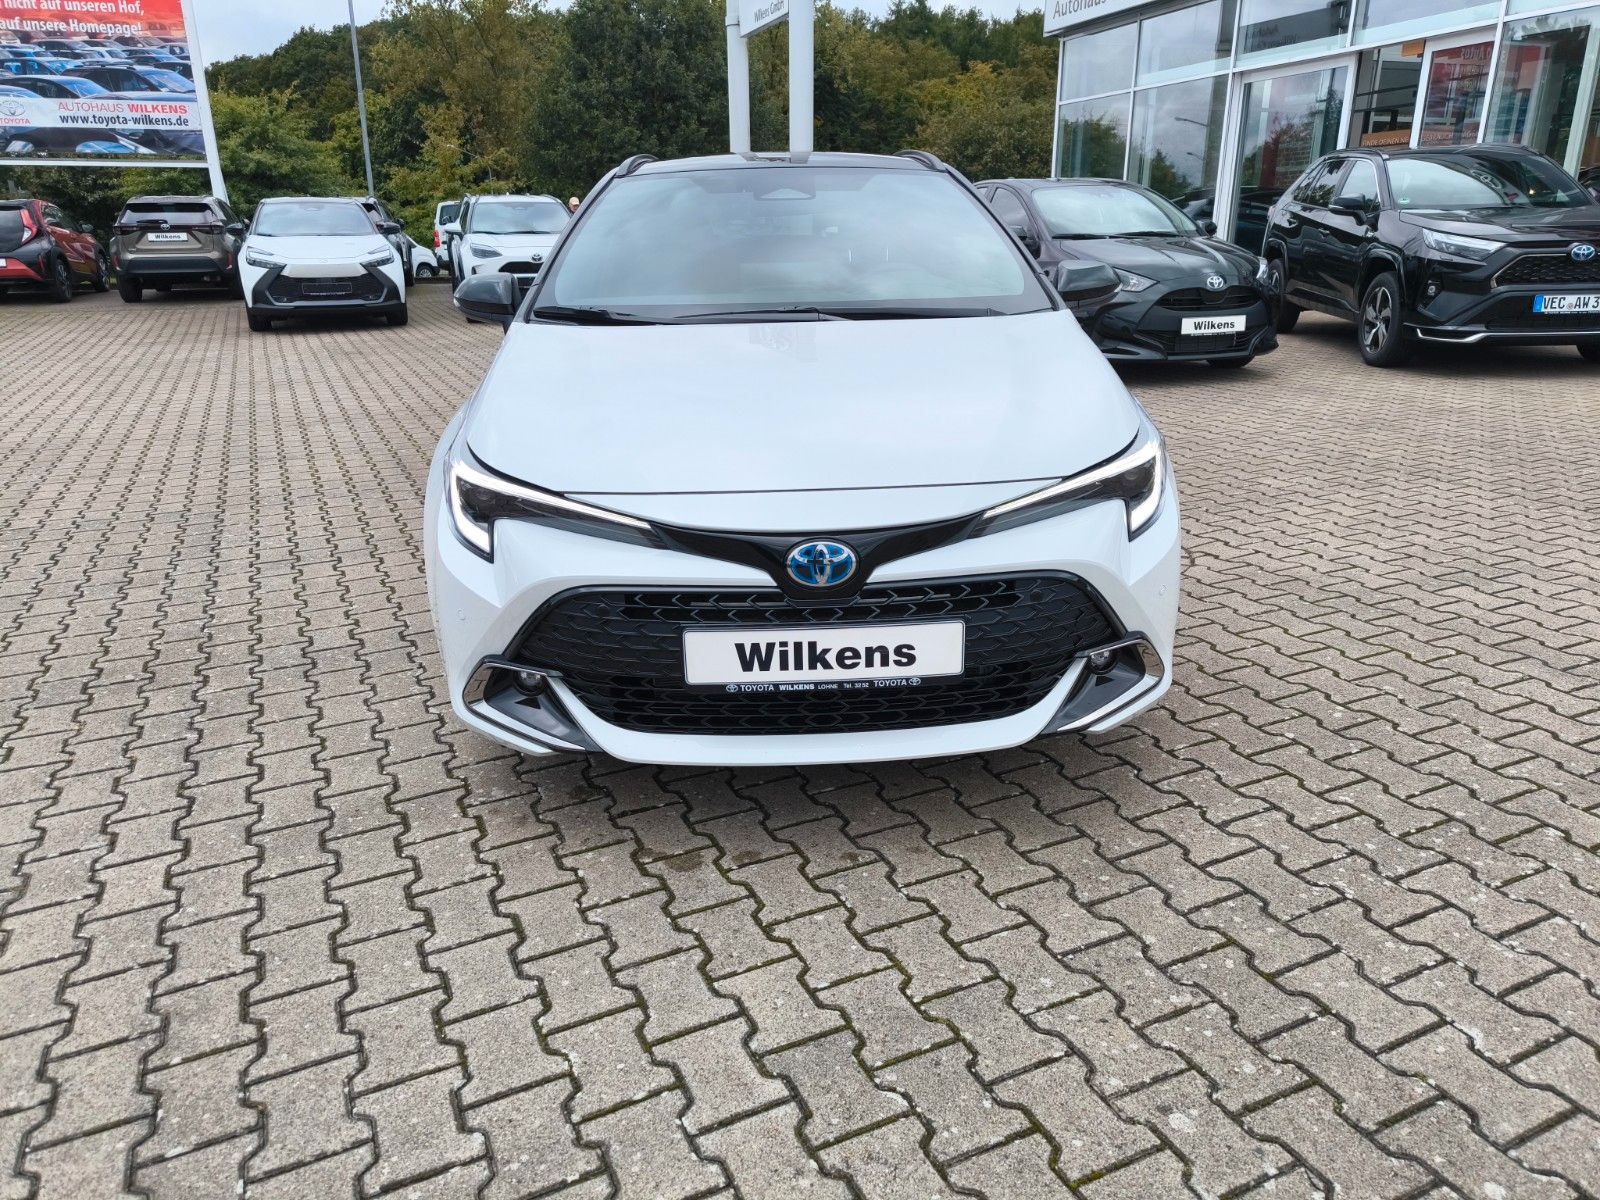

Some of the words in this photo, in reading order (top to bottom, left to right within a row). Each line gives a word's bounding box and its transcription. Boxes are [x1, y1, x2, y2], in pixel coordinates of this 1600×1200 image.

[40, 0, 61, 10] auf
[64, 0, 116, 13] unseren
[118, 0, 144, 16] Hof,
[1052, 0, 1107, 19] Autoha
[0, 16, 20, 30] auf
[22, 19, 67, 32] unsere
[69, 19, 142, 38] Homepage!
[58, 101, 124, 113] AUTOHAUS
[127, 103, 188, 115] WILKENS
[0, 117, 32, 125] TOYOTA
[59, 114, 189, 127] www.toyota-wilkens.de
[1543, 296, 1566, 310] VEC
[1193, 320, 1235, 331] Wilkens
[734, 641, 917, 673] Wilkens
[740, 683, 774, 692] TOYOTA
[778, 683, 815, 691] WILKENS
[873, 678, 907, 688] TOYOTA
